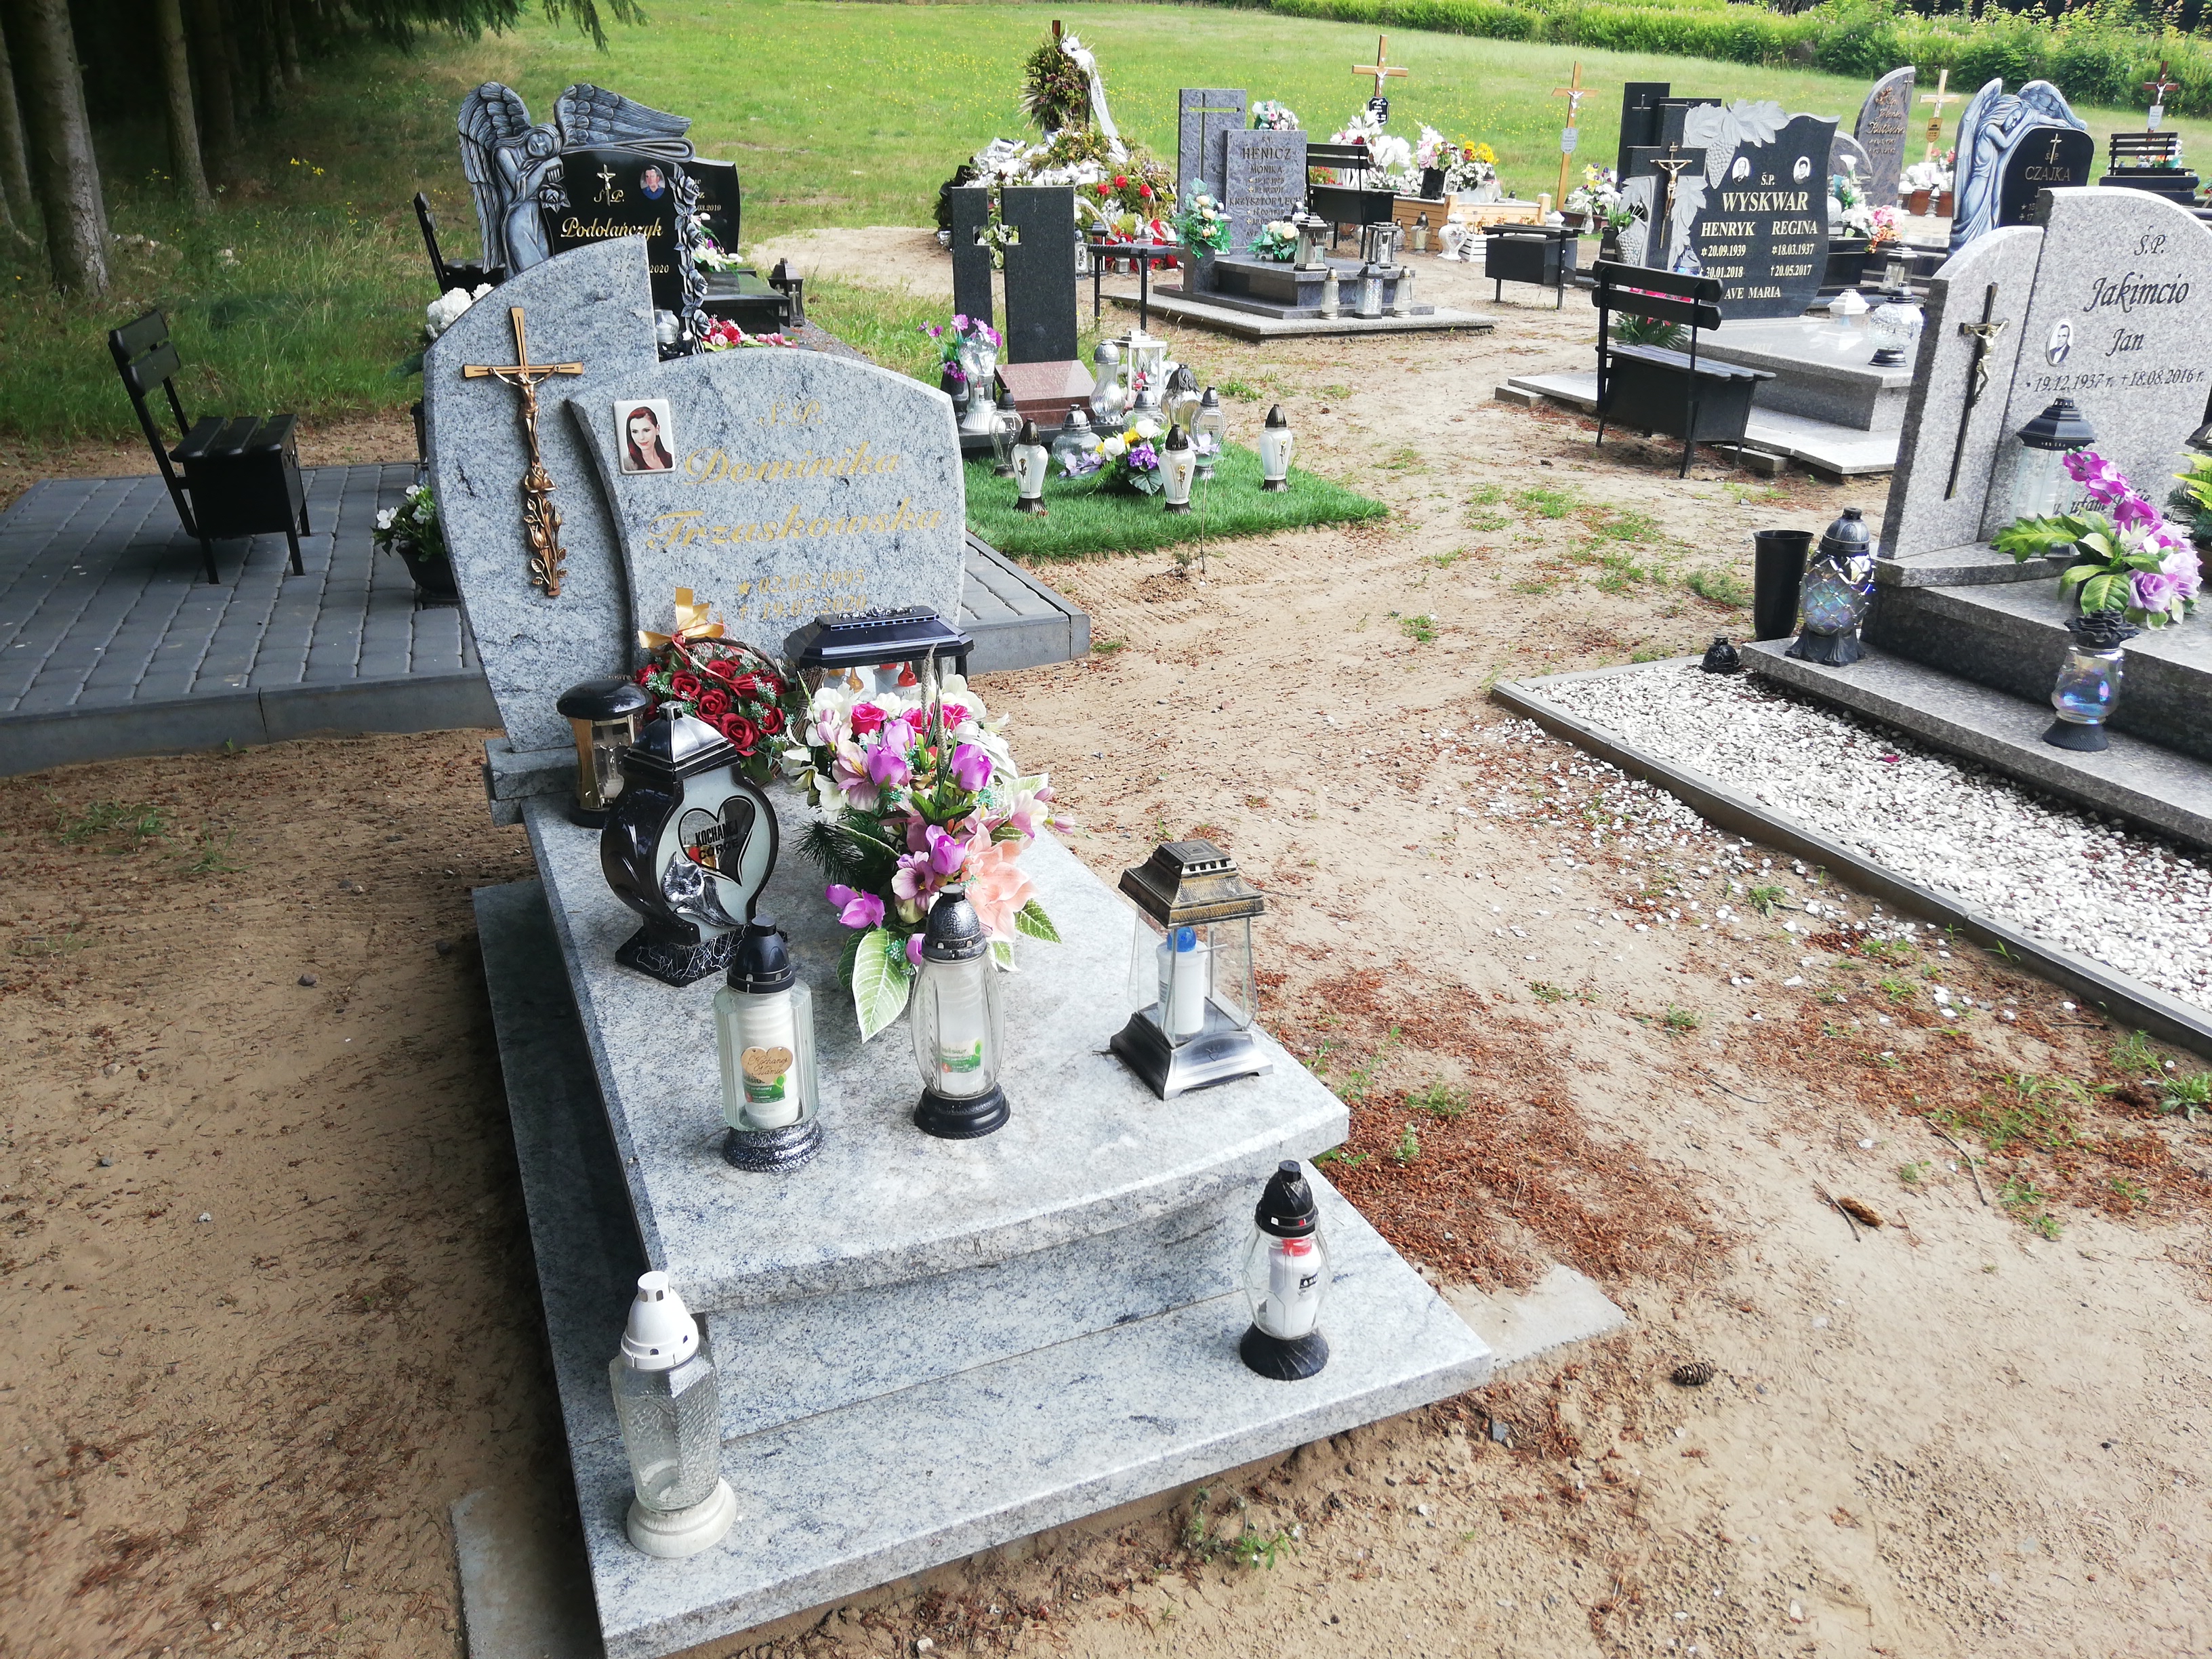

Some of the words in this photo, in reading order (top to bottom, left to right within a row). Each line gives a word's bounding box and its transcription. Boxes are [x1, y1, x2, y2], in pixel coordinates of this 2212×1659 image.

[1243, 147, 1291, 159] HENICZ
[1250, 165, 1283, 174] MONIKA
[2025, 166, 2070, 181] CZAJKA
[1229, 197, 1277, 206] KRZYSZTOF
[1722, 192, 1808, 211] WYSKWAR
[560, 217, 663, 241] Podolańczyk
[1700, 222, 1757, 237] HENRYK
[1771, 220, 1818, 235] REGINA
[1708, 245, 1746, 256] 20.09.1939
[1778, 243, 1814, 255] 18.03.1937
[1774, 264, 1811, 276] 20.05.2017
[1724, 287, 1744, 299] AVE
[1748, 286, 1781, 298] MARIA
[2083, 272, 2190, 313] Jakimcio
[2105, 328, 2145, 356] Jan
[683, 441, 900, 485] Dominika
[647, 497, 943, 550] Trzaskowska
[758, 569, 865, 594] 02.03.1995
[762, 594, 867, 619] 19.07.2020
[695, 819, 739, 847] KOCHANEJ
